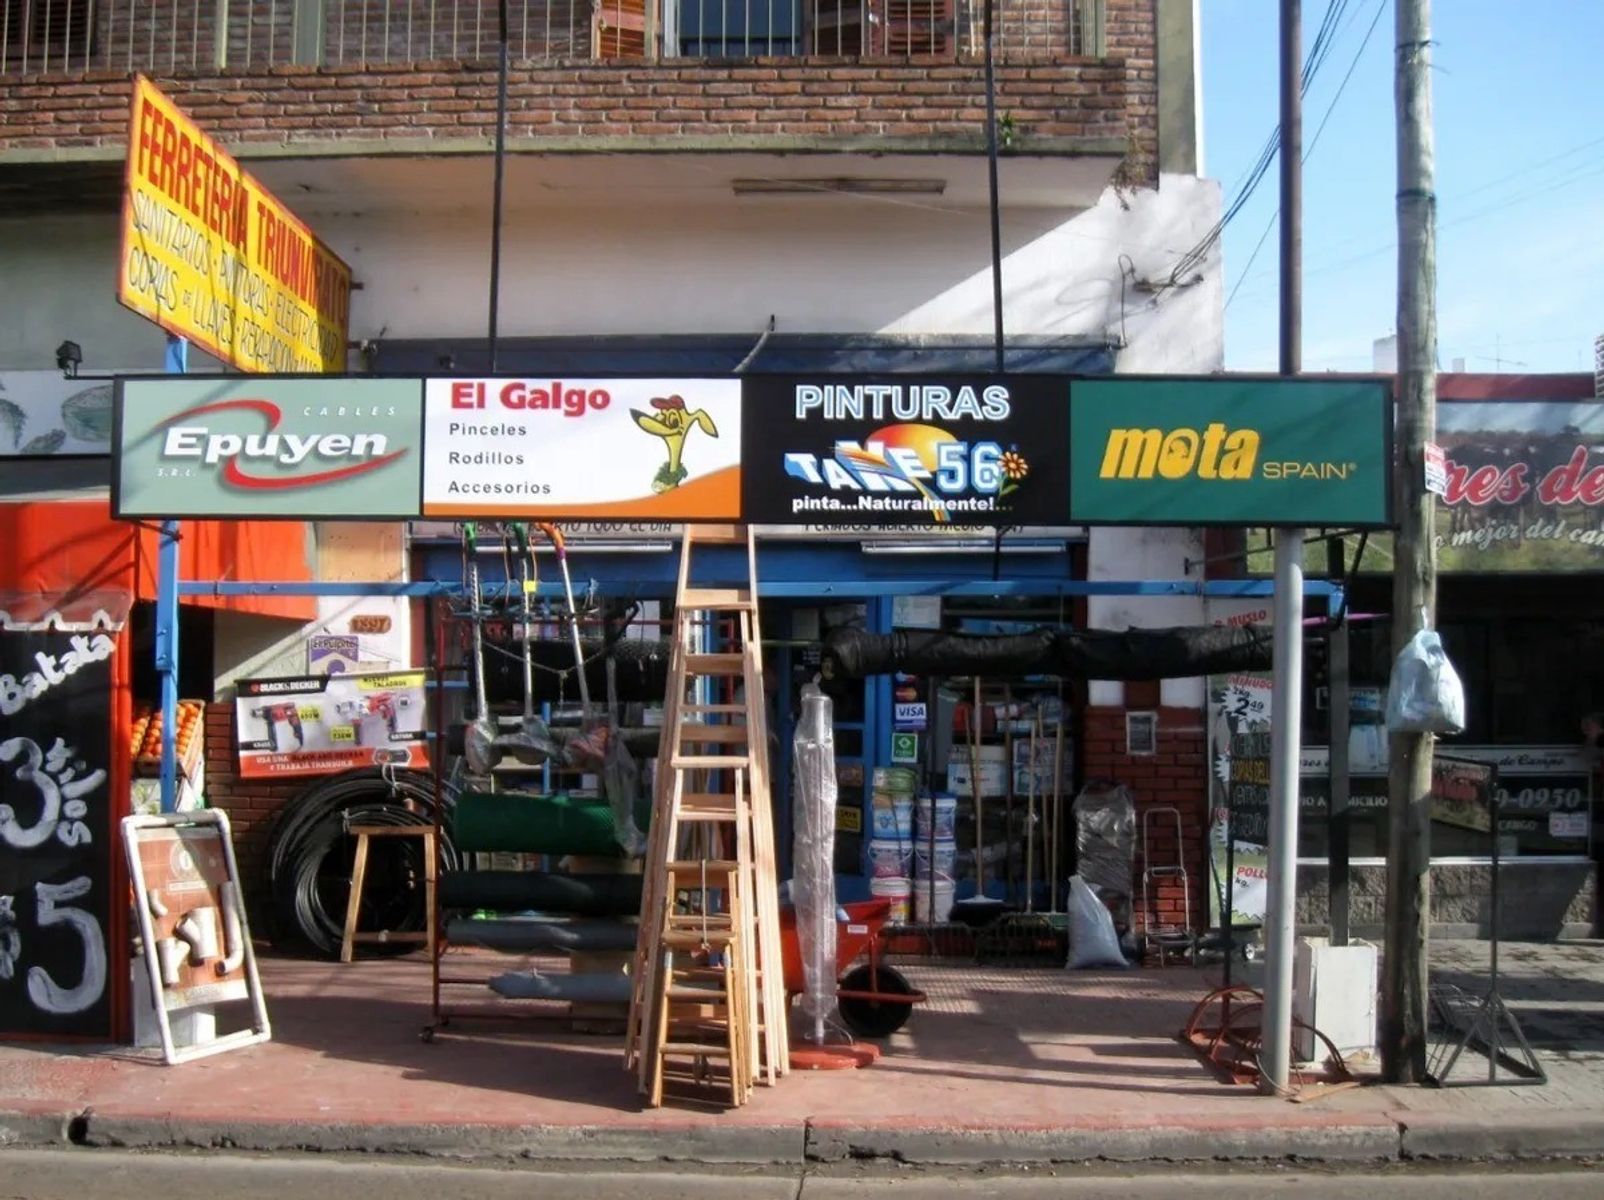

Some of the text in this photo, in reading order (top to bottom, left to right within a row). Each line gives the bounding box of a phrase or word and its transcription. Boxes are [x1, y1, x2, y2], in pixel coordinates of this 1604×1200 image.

[138, 96, 249, 254] FERRETERIA
[132, 188, 212, 276] SANITARIOS
[220, 249, 271, 317] PINTURAS
[128, 246, 179, 311] COPIAS
[194, 285, 236, 344] LLAVES
[303, 405, 396, 416] CABLES
[451, 381, 611, 417] El Galgo
[795, 384, 1011, 420] PINTURAS
[163, 426, 388, 464] Epuyen
[449, 422, 527, 436] Pinceles
[449, 451, 525, 465] Rodillos
[936, 440, 1004, 493] 56
[1099, 422, 1260, 480] mota
[448, 480, 551, 495] Accesorios
[1538, 444, 1604, 505] de
[1452, 517, 1519, 550] mejor
[1526, 518, 1566, 540] del
[0, 634, 117, 716] Batata
[899, 707, 925, 717] VISA
[27, 875, 108, 1014] 5
